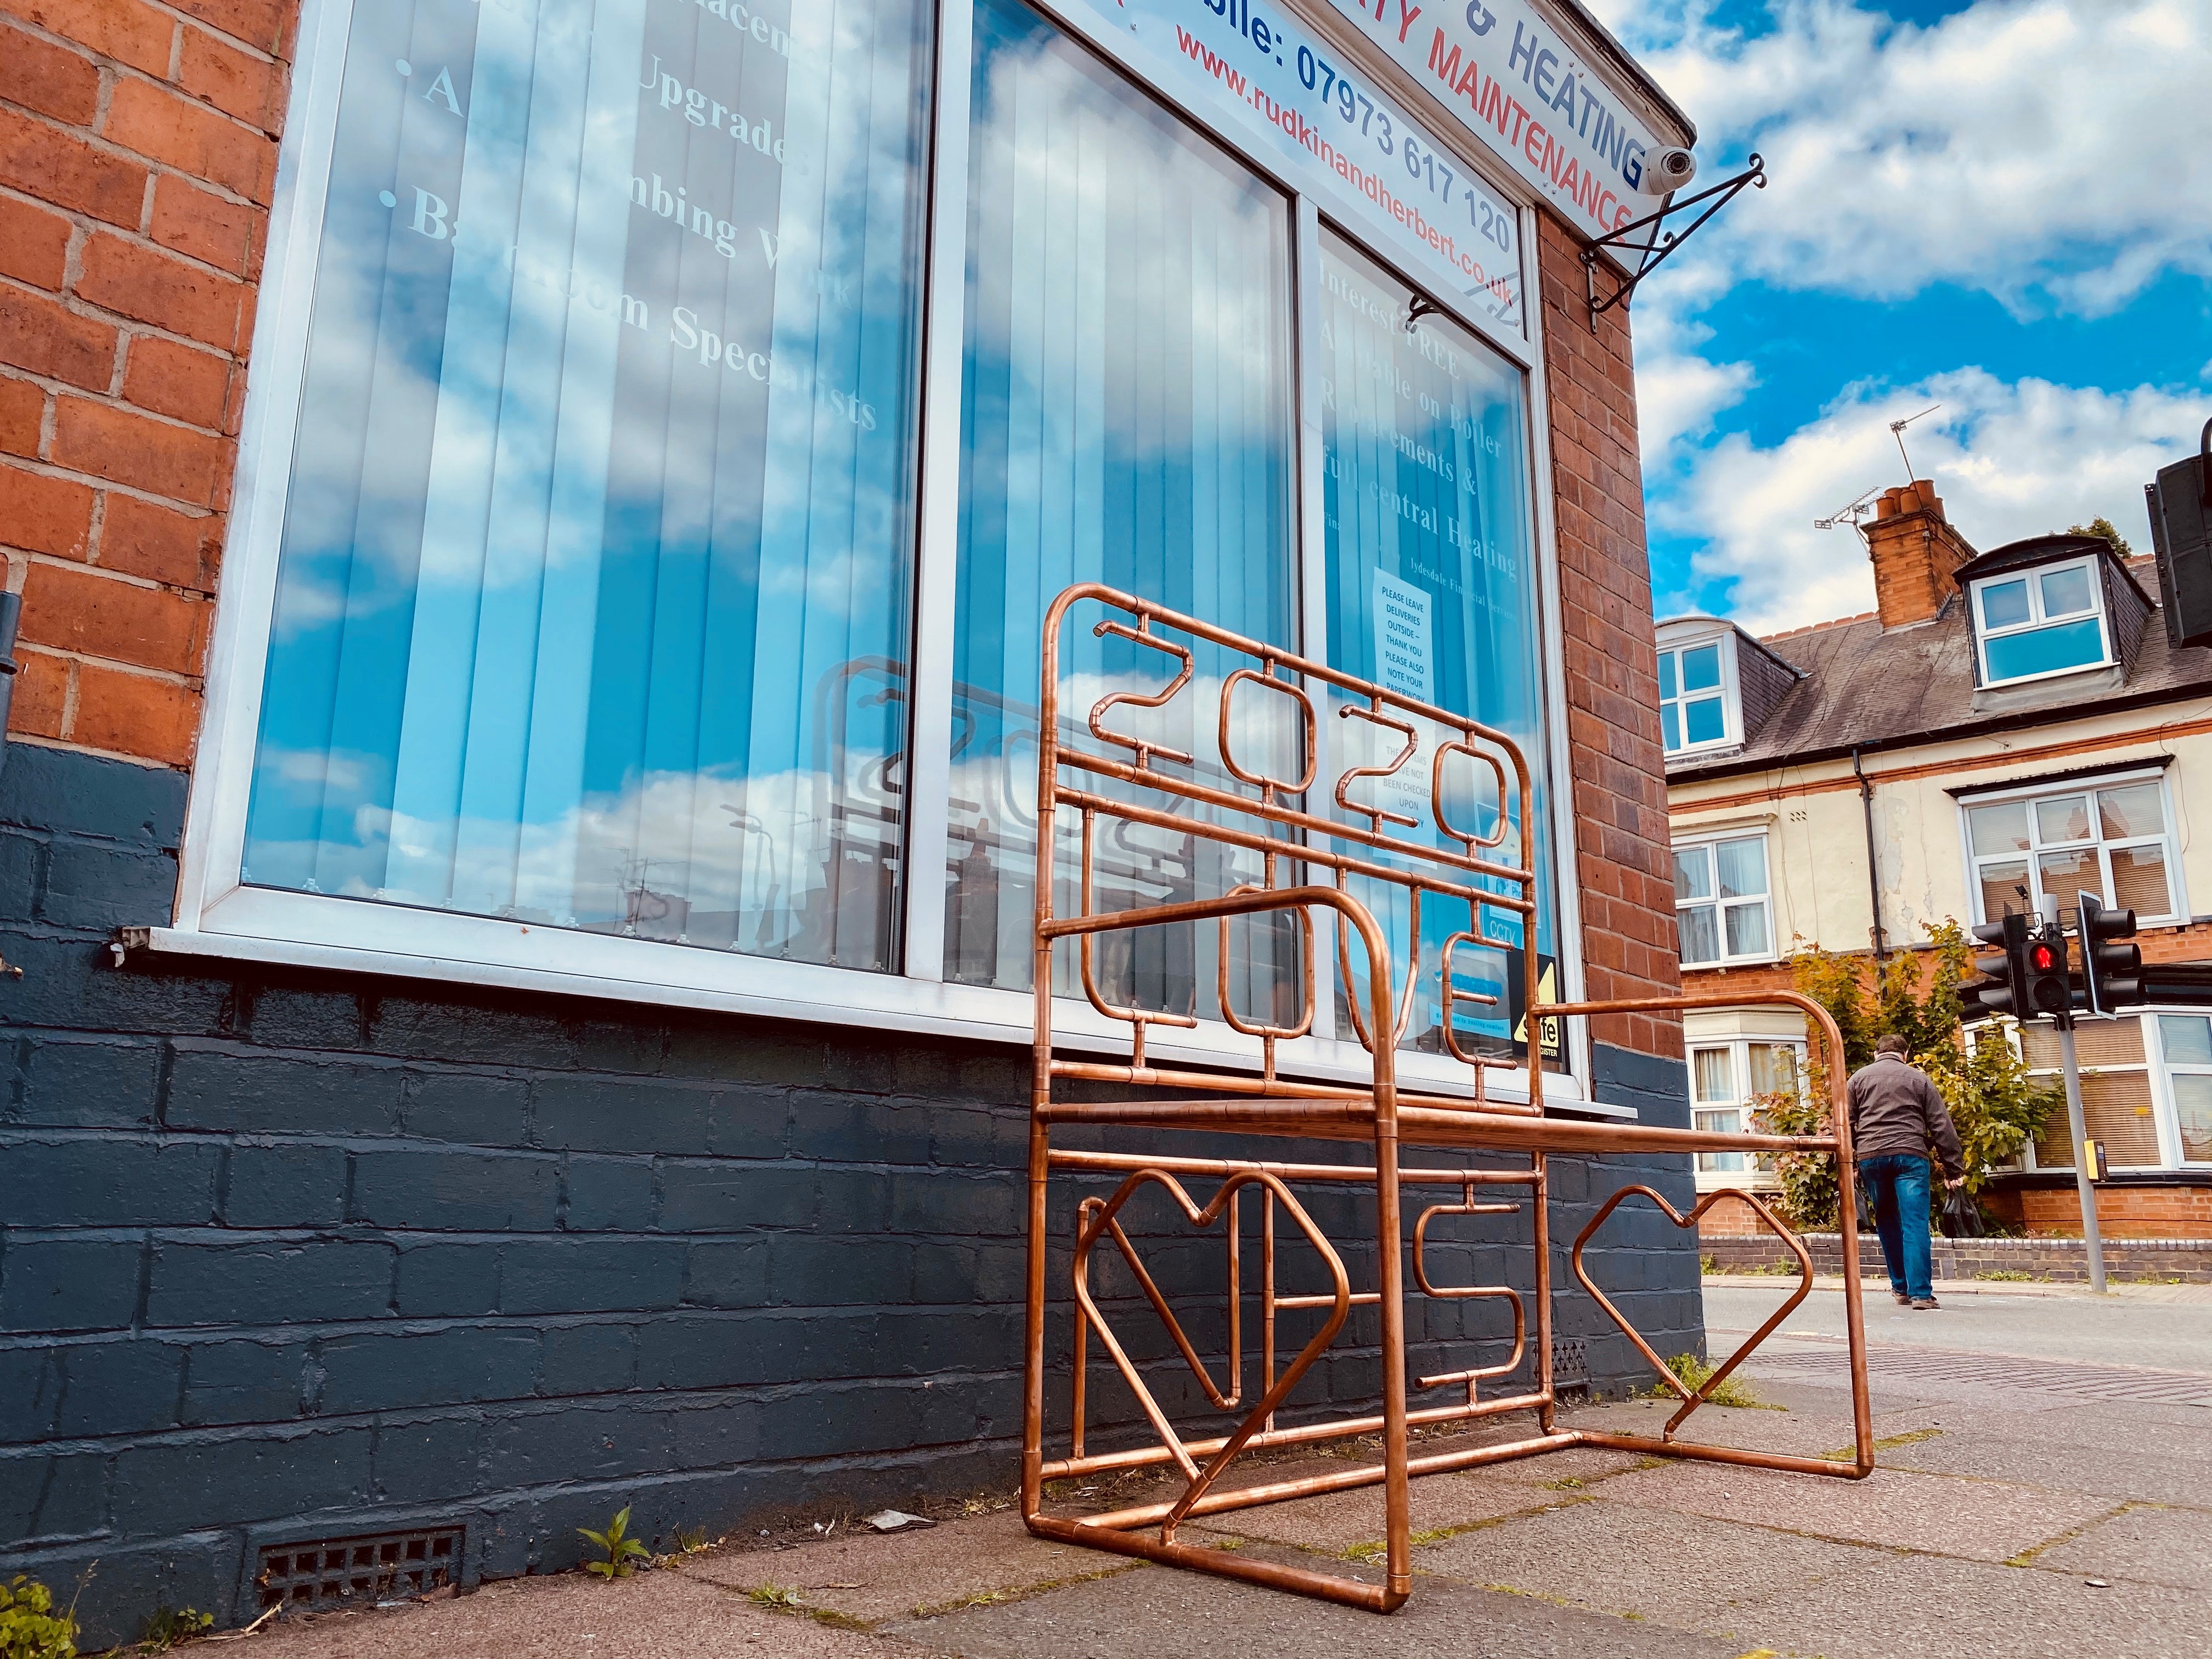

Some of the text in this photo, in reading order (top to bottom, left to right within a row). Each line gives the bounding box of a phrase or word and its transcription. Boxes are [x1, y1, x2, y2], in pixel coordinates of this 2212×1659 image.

[1509, 20, 1646, 191] HEATING
[1427, 26, 1633, 243] MAINTENANCE
[1297, 46, 1393, 156] 07973
[1404, 137, 1453, 204] 617
[1465, 189, 1509, 253] 120
[1176, 24, 1513, 307] www.rudkinandherbert.co.uk
[1318, 256, 1460, 380] Interest FREE
[1419, 392, 1441, 421] on
[1449, 403, 1502, 459] Boiler
[1463, 467, 1476, 495] &
[1369, 481, 1439, 535] central
[1447, 516, 1516, 583] Heating
[1409, 556, 1447, 586] lydesdale
[1382, 586, 1424, 613] PLEASE LEAVE
[1386, 604, 1420, 626] DELIVERIES
[1387, 620, 1414, 639] OUTSIDE
[1386, 634, 1422, 657] THANK YOU
[1385, 651, 1424, 674] PLEASE ALSO
[1387, 667, 1423, 689] NOTE YOUR
[1088, 619, 1507, 848] 2020
[1409, 753, 1426, 765] TEMS
[1396, 766, 1424, 780] AVE NOT
[1383, 777, 1431, 798] BEEN CHECKED
[1399, 798, 1419, 811] UPON
[1489, 920, 1516, 943] CCTV
[1523, 1017, 1556, 1042] sfe
[1540, 1047, 1558, 1057] GISTER
